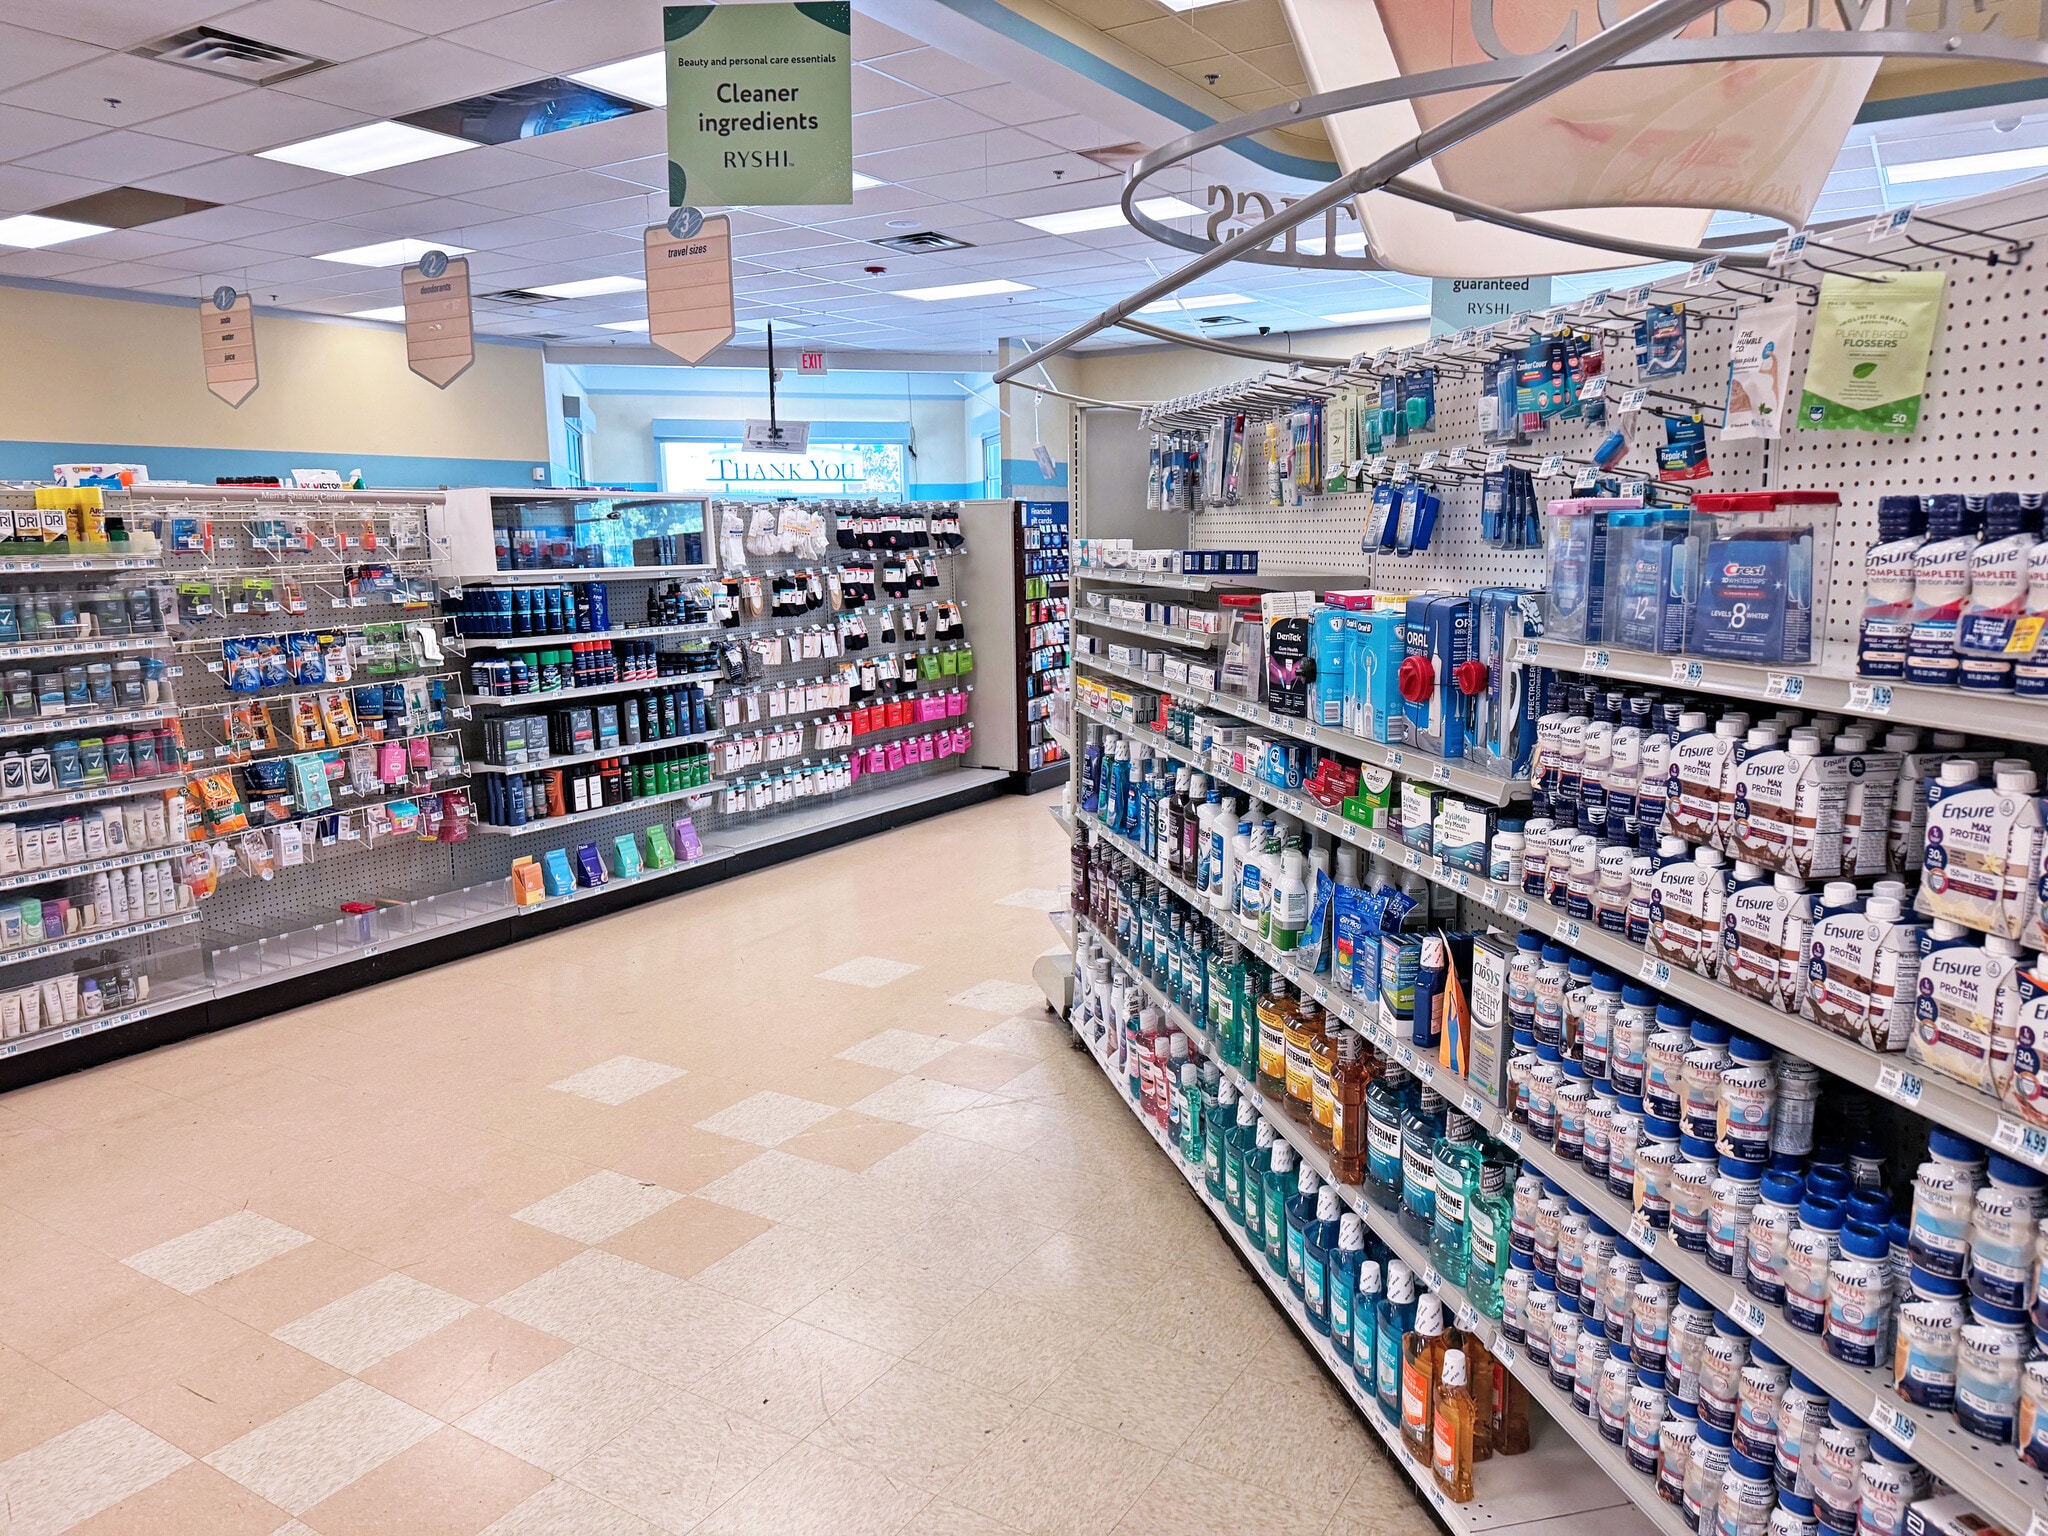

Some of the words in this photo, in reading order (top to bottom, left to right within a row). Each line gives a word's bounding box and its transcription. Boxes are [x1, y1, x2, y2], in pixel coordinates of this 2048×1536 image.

[678, 57, 708, 68] Beauty
[710, 57, 727, 67] and
[729, 56, 768, 67] personal
[770, 56, 789, 65] care
[791, 54, 836, 64] essentials
[716, 82, 799, 104] Cleaner
[699, 110, 819, 137] ingredients
[680, 212, 690, 233] 3
[667, 245, 689, 259] travel
[689, 244, 707, 255] sizes
[427, 254, 437, 274] 2
[420, 282, 452, 295] deodorants
[1452, 277, 1530, 293] guaranteed
[219, 316, 231, 325] soda
[221, 332, 235, 343] water
[1736, 336, 1762, 346] HUMBLE
[1740, 330, 1754, 338] THE
[1835, 329, 1870, 340] PLANT
[1872, 329, 1908, 340] BASED
[1843, 338, 1898, 349] FLOSSERS
[224, 352, 236, 363] juice
[802, 353, 823, 369] EXIT
[1891, 413, 1908, 424] 50
[711, 458, 801, 480] THANK
[809, 459, 855, 480] YOU
[18, 516, 38, 528] DRI
[44, 515, 64, 526] DRI
[1970, 549, 2018, 568] nsure
[1636, 561, 1658, 573] Crest
[1724, 563, 1766, 577] Crest
[1634, 596, 1649, 621] 12
[1711, 610, 1732, 620] LEVELS
[1731, 602, 1746, 629] 8
[1746, 612, 1769, 621] WHITER
[1276, 632, 1302, 642] DenTek
[1407, 631, 1429, 648] ORAL
[1226, 649, 1240, 657] Crest
[1872, 686, 1892, 704] 14.99
[1679, 744, 1714, 758] Ensure
[1683, 764, 1711, 777] PROTEIN
[1697, 759, 1712, 769] MAX
[1745, 763, 1785, 776] Ensure
[1751, 784, 1782, 797] PROTEIN
[1767, 778, 1783, 789] MAX
[216, 798, 233, 808] BIC
[1445, 812, 1471, 824] XyliMelts
[1942, 803, 1994, 819] Ensure
[1444, 819, 1454, 828] Dry
[1454, 822, 1467, 830] Mouth
[1970, 822, 1992, 834] MAX
[1950, 828, 1991, 845] PROTEIN
[1660, 871, 1695, 886] Ensure
[1665, 890, 1693, 906] PROTEIN
[1679, 887, 1693, 898] MAX
[1736, 894, 1774, 911] Ensure
[1740, 916, 1770, 933] PROTEIN
[1756, 912, 1771, 924] MAX
[1823, 922, 1865, 941] Ensure
[1829, 945, 1862, 964] PROTEIN
[1846, 942, 1862, 956] MAX
[1655, 962, 1669, 981] 14.99
[1932, 957, 1982, 977] Ensure
[1940, 981, 1978, 1003] PROTEIN
[1959, 978, 1979, 992] MAX
[1473, 986, 1500, 1011] HEALTHY
[1475, 999, 1497, 1022] TEETH
[1658, 1051, 1683, 1063] PLUS
[1683, 1056, 1722, 1070] Ensure
[1695, 1069, 1721, 1081] PLUS
[1722, 1074, 1767, 1090] Ensure
[1901, 1072, 1922, 1095] 14.99
[1738, 1087, 1766, 1099] PLUS
[1378, 1138, 1392, 1150] MINT
[2023, 1127, 2047, 1153] 14.99
[1836, 1284, 1866, 1300] PLUS
[1749, 1306, 1766, 1326] 13.99
[1902, 1308, 1953, 1329] Ensure
[1914, 1325, 1952, 1342] Original
[1868, 1487, 1897, 1506] PLUS
